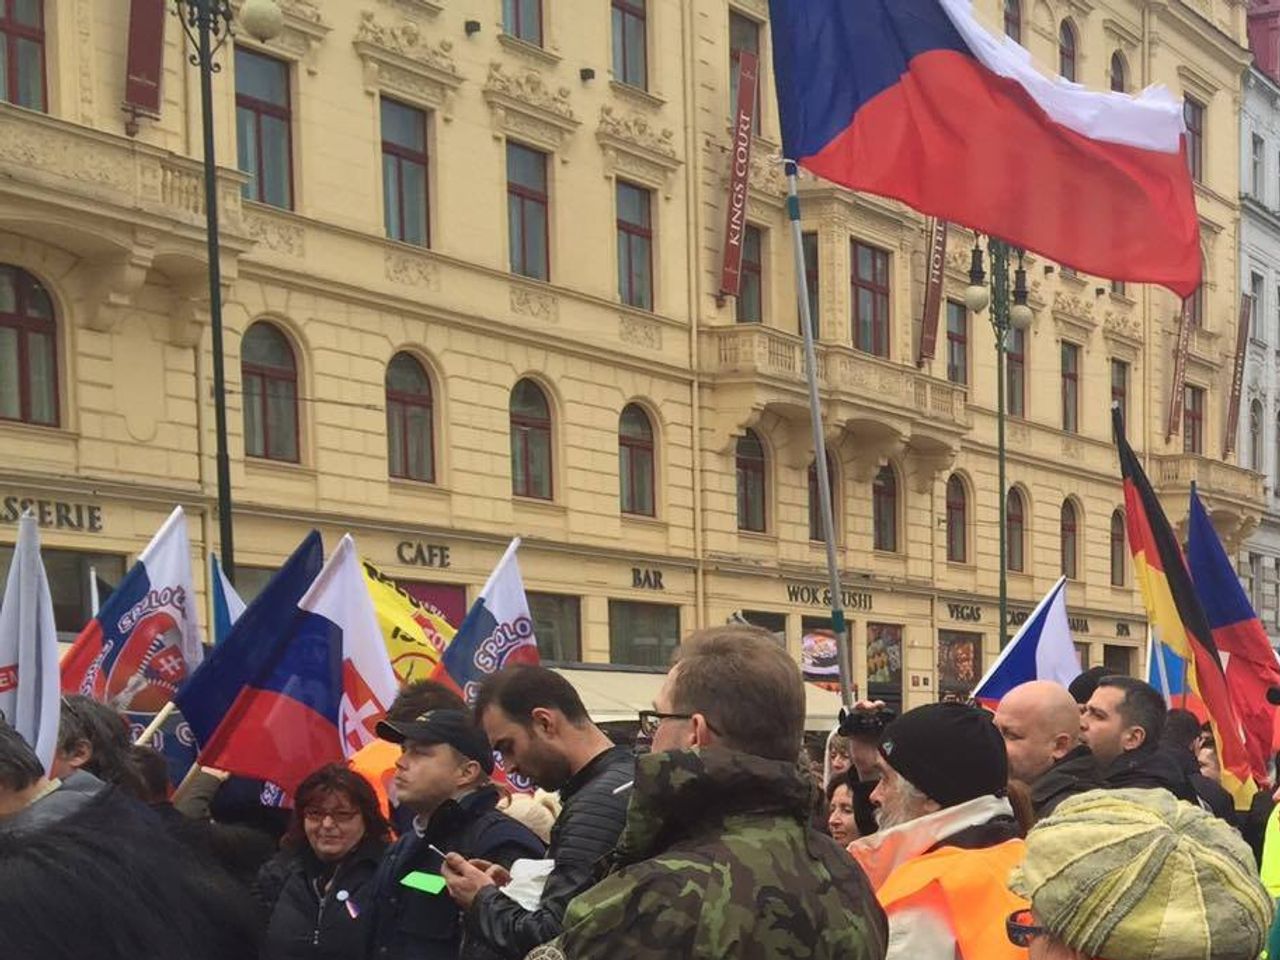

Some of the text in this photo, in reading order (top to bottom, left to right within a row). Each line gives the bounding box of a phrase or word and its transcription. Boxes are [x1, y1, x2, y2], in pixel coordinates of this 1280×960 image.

[729, 112, 750, 246] KINGS COURT
[931, 221, 944, 284] HOTEL
[0, 496, 103, 533] SSERIE
[397, 542, 450, 568] CAFE
[632, 567, 665, 590] BAR
[786, 584, 822, 606] WOK
[840, 590, 873, 610] USHI
[947, 603, 981, 622] VEGAS
